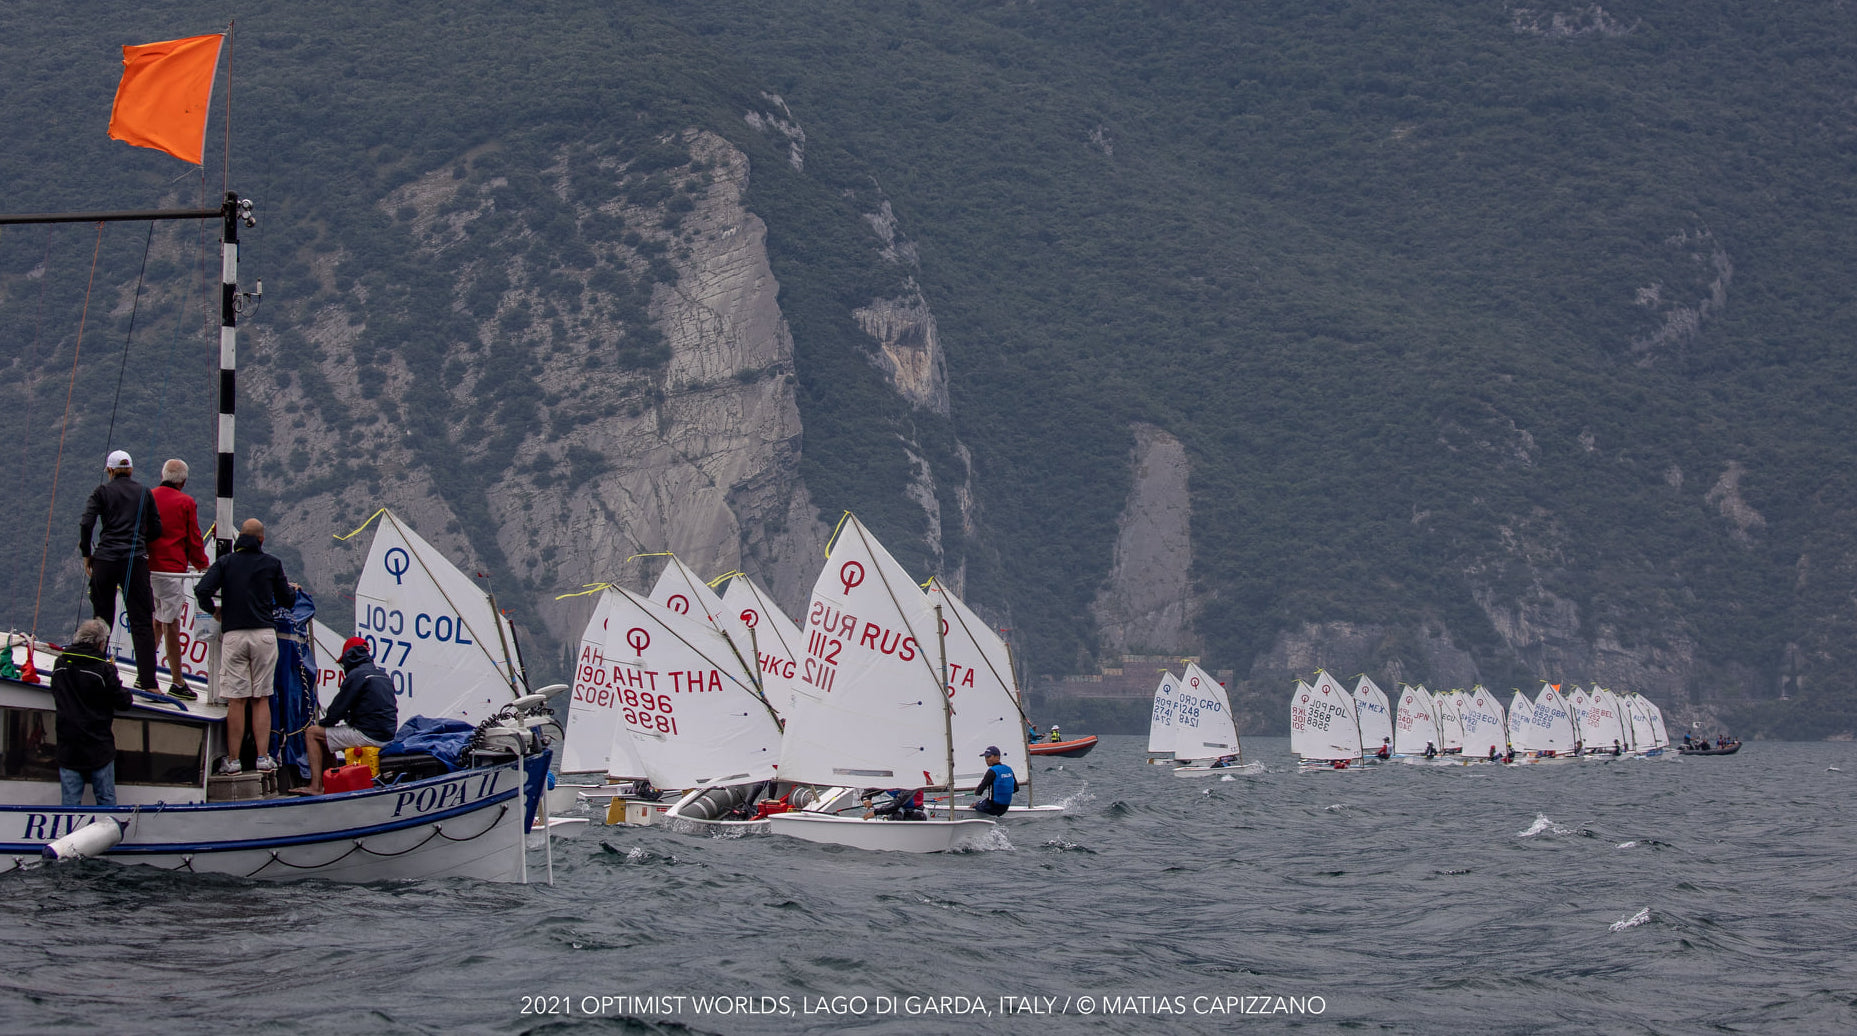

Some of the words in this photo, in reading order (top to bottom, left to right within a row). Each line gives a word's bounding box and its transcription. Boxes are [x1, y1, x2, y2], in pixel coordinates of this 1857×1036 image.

[415, 613, 472, 645] COL
[358, 631, 412, 667] 077
[808, 629, 842, 665] 1112
[860, 622, 920, 661] RUS
[577, 664, 613, 688] 190
[758, 651, 797, 679] HKG
[949, 663, 974, 688] TA
[668, 669, 723, 692] THA
[616, 686, 673, 714] 1896
[1180, 703, 1200, 717] 1248
[1200, 699, 1221, 712] CRO
[1328, 705, 1347, 718] POL
[1368, 703, 1385, 714] MEX
[1308, 707, 1331, 722] 3568
[1414, 712, 1430, 721] JPN
[391, 780, 467, 817] POPA
